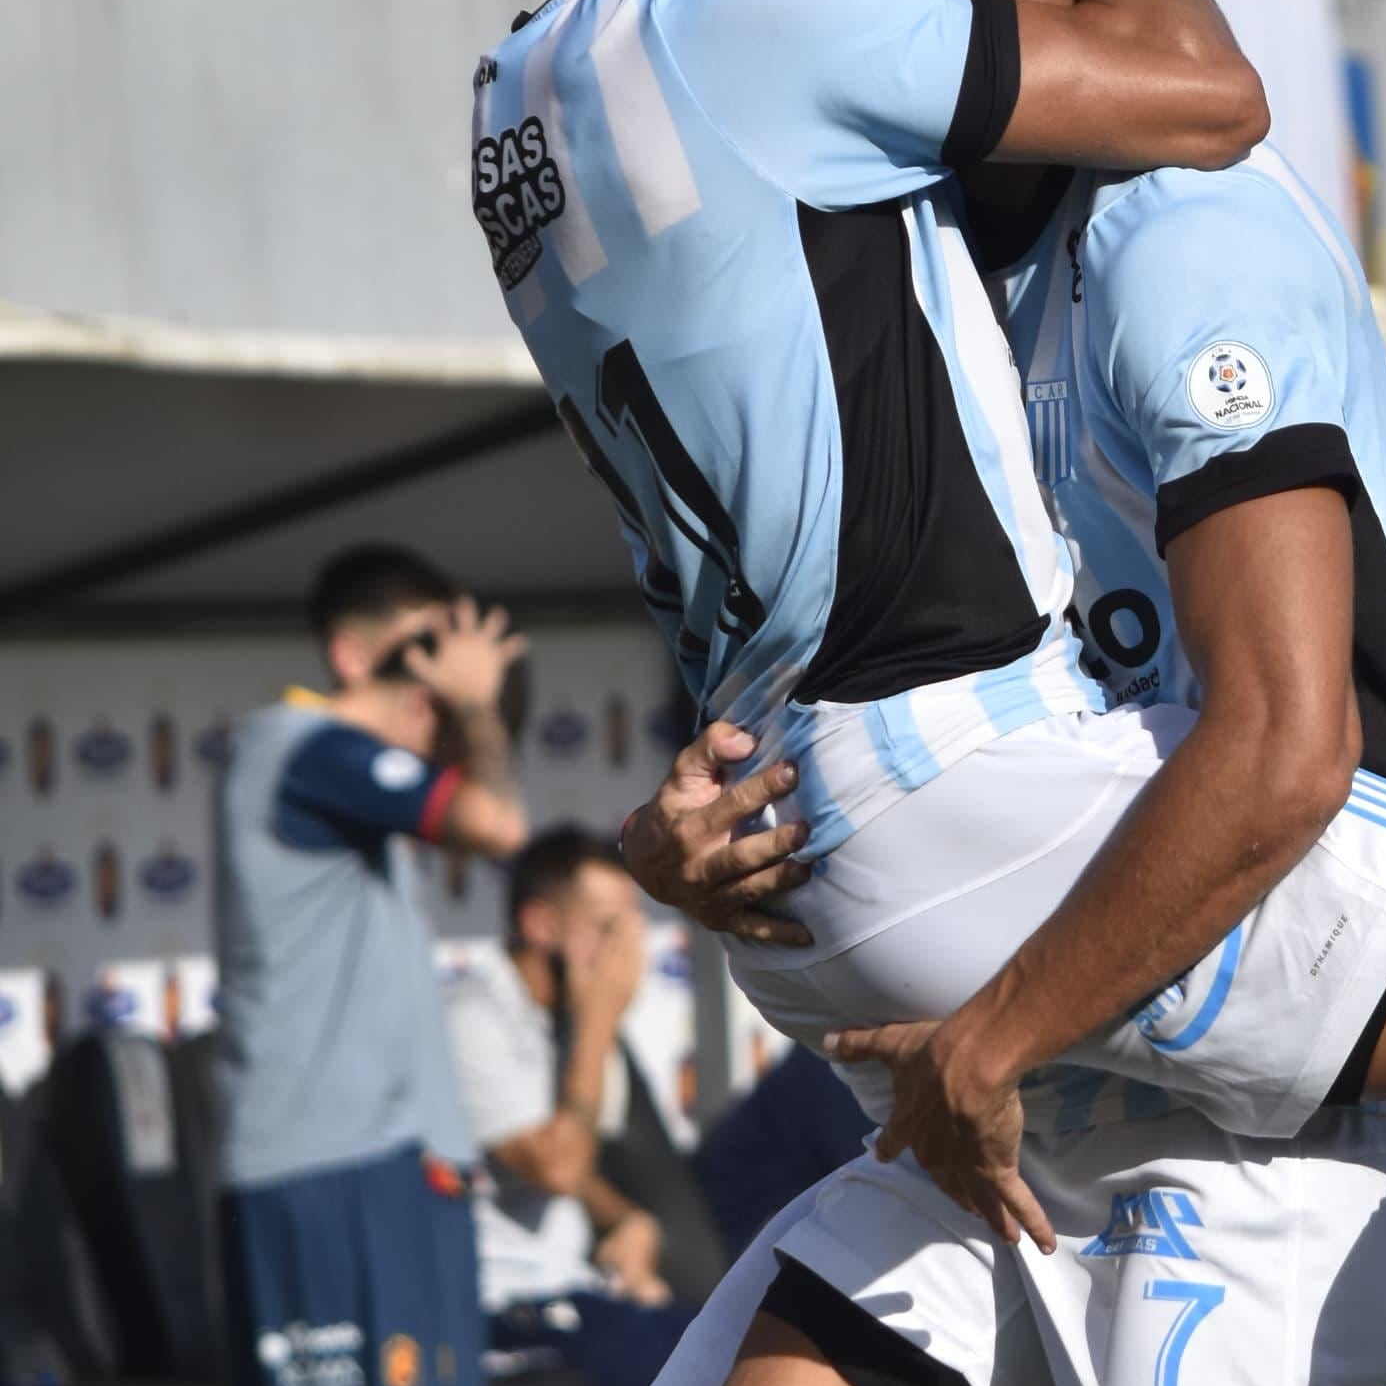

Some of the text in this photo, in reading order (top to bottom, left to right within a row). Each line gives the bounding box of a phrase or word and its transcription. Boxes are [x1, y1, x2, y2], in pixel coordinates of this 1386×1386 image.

[472, 124, 543, 203] SAS
[476, 166, 560, 259] SCAS
[1214, 400, 1264, 419] NACIONAL
[1309, 914, 1349, 977] DYNAMIQUE
